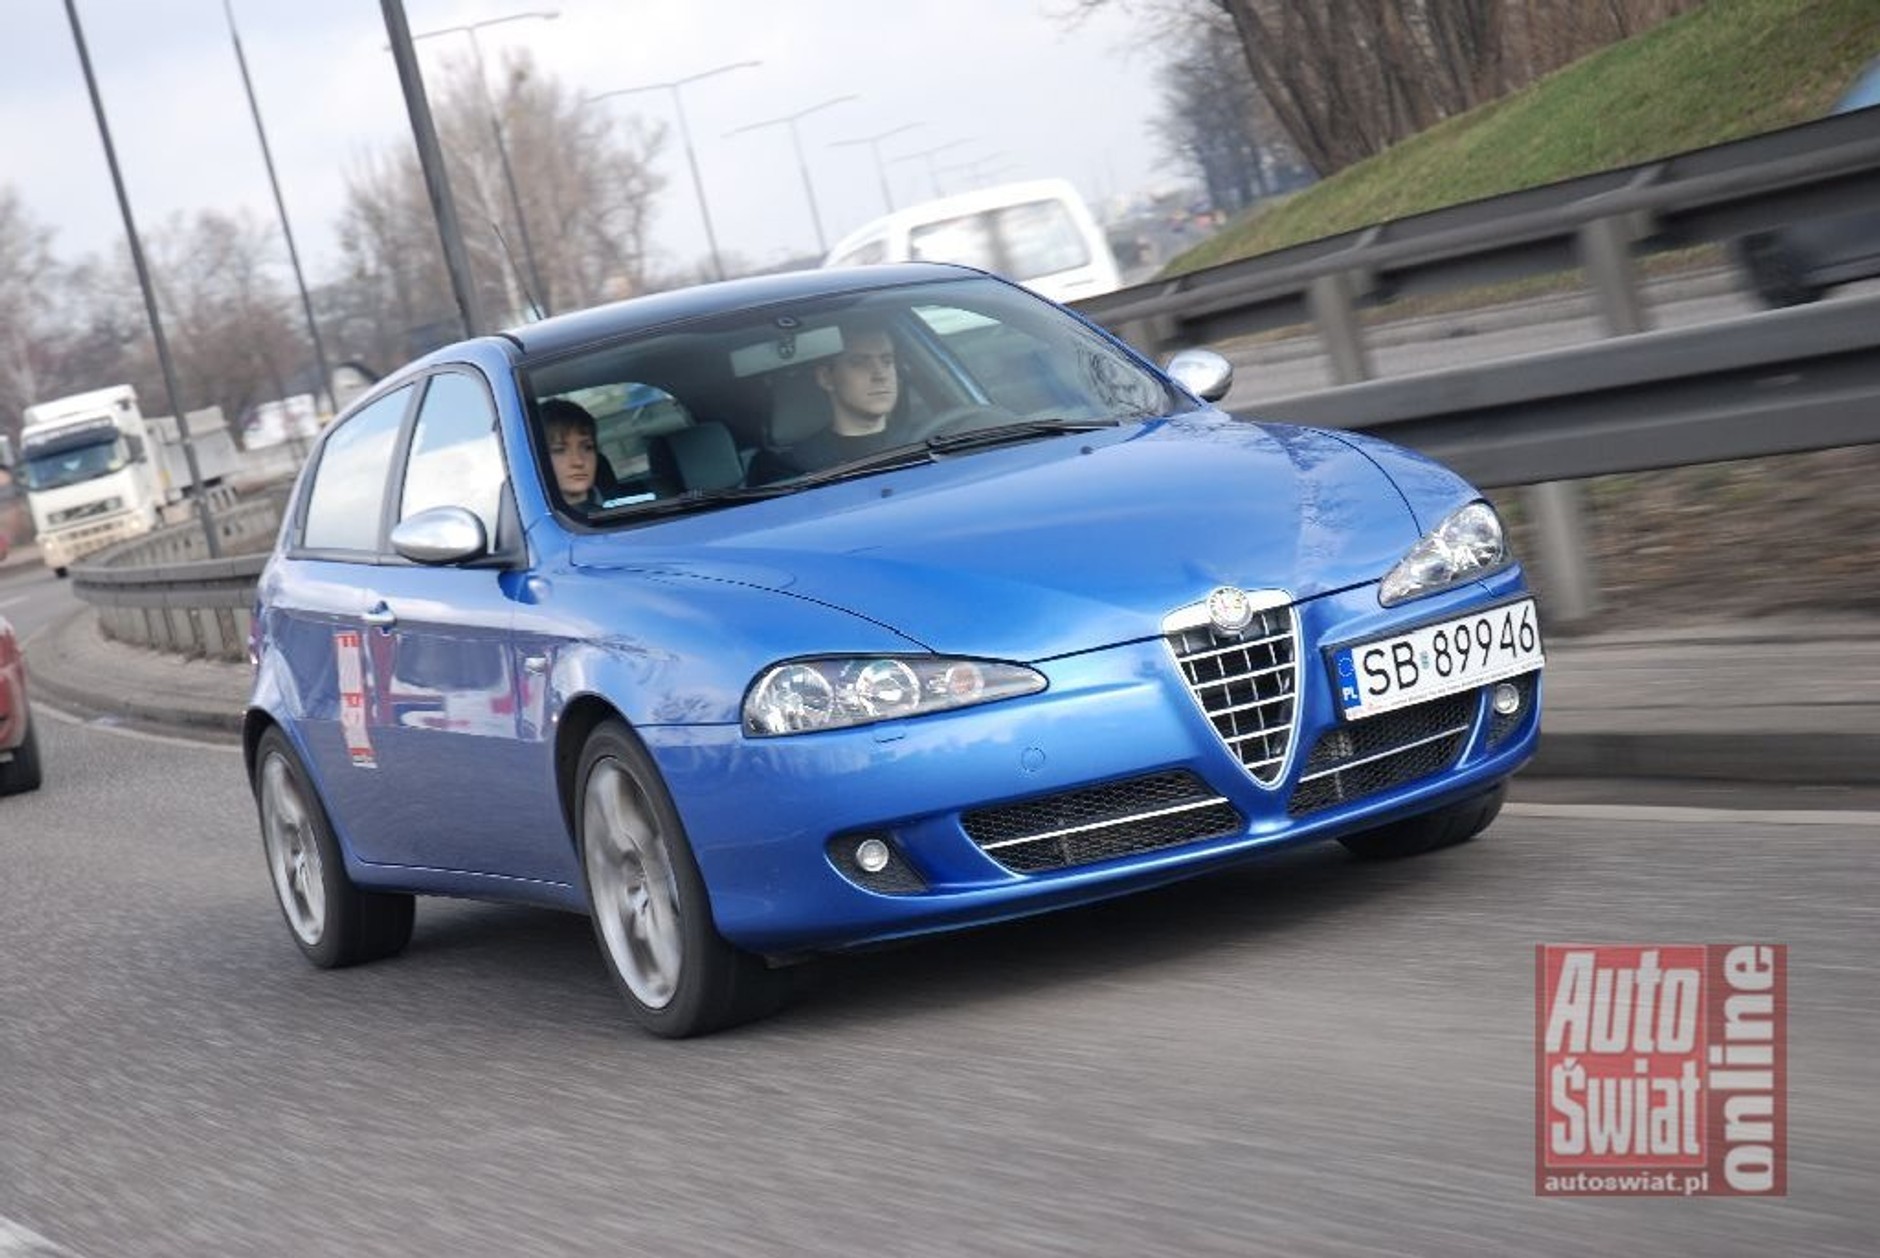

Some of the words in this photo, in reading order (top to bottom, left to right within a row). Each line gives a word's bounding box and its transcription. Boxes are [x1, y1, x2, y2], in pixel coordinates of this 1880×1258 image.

[1363, 641, 1419, 696] SB
[1433, 606, 1535, 677] 89946
[1342, 687, 1358, 700] PL
